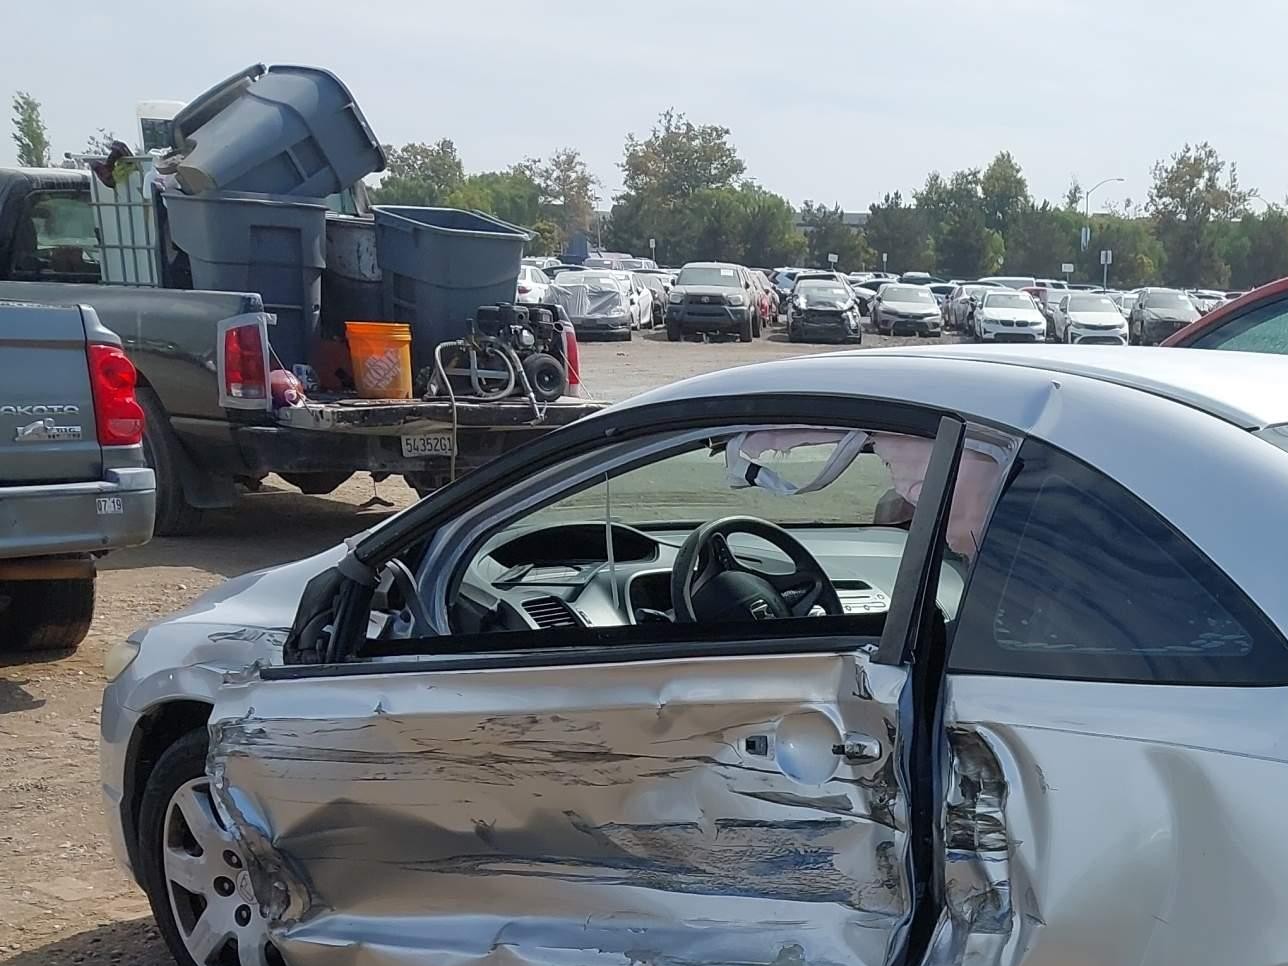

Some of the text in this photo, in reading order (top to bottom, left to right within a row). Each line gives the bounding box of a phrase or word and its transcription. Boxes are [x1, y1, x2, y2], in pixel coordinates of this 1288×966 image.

[0, 405, 80, 415] AKOTA
[405, 436, 453, 453] 54352G1
[111, 498, 122, 511] 19
